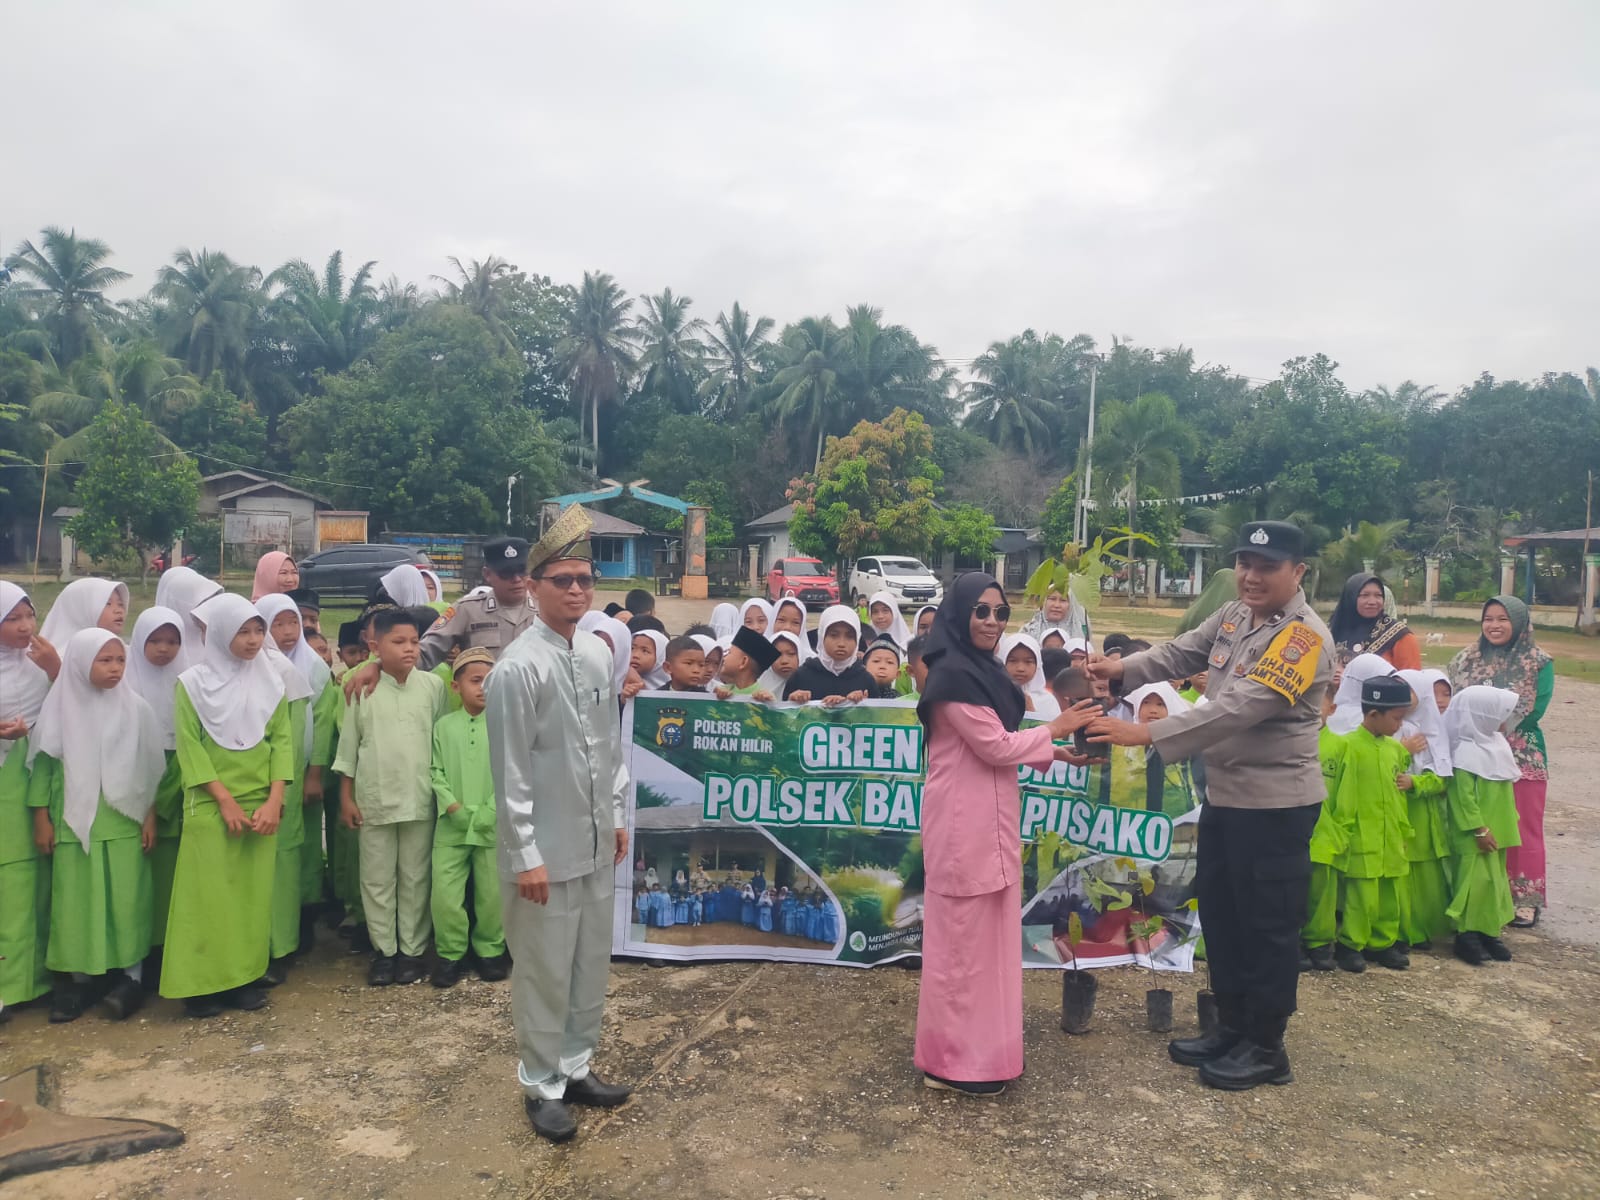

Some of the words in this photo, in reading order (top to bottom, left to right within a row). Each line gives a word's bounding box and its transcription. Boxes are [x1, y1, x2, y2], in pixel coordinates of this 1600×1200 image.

[1260, 657, 1305, 687] BHABIN
[694, 719, 742, 736] POLRES
[693, 735, 738, 752] ROKAN
[740, 737, 773, 754] HILIR
[802, 725, 922, 771] GREEN
[706, 776, 852, 823] POLSEK
[864, 780, 924, 827] BA
[1022, 796, 1170, 859] PUSAKO
